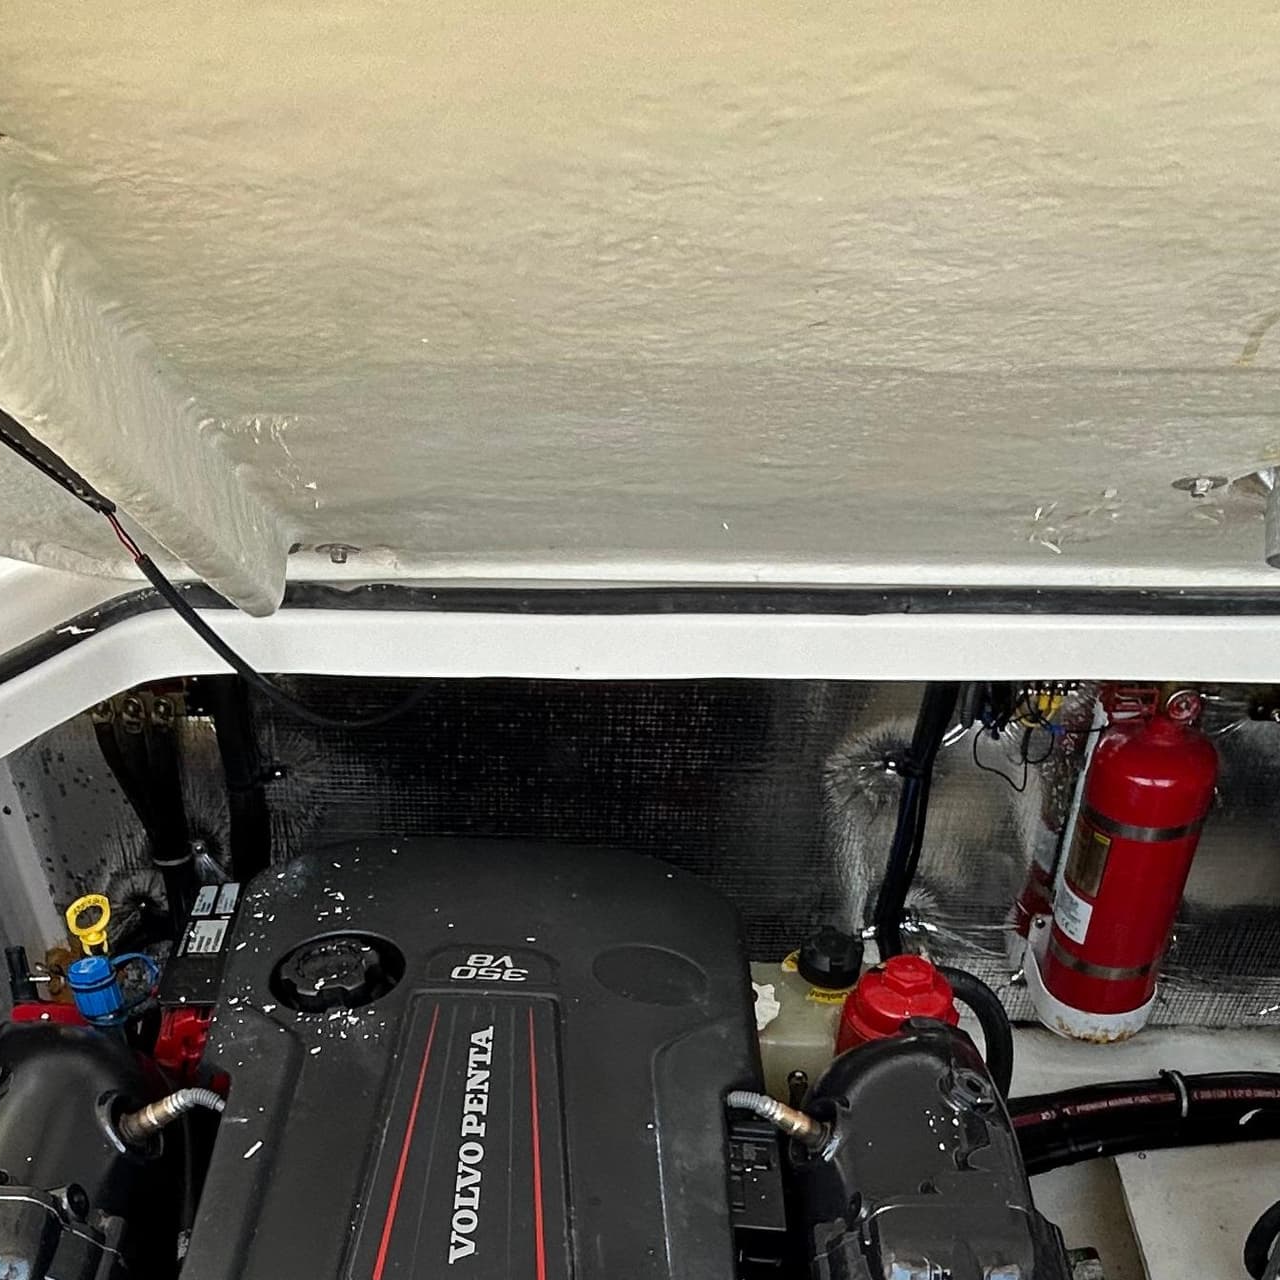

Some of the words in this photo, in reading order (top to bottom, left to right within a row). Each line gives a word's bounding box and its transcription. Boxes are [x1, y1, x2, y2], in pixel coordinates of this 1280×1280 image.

[450, 966, 528, 981] 350
[466, 953, 513, 968] V8
[461, 1025, 494, 1137] PENTA
[448, 1141, 485, 1264] VOLVO
